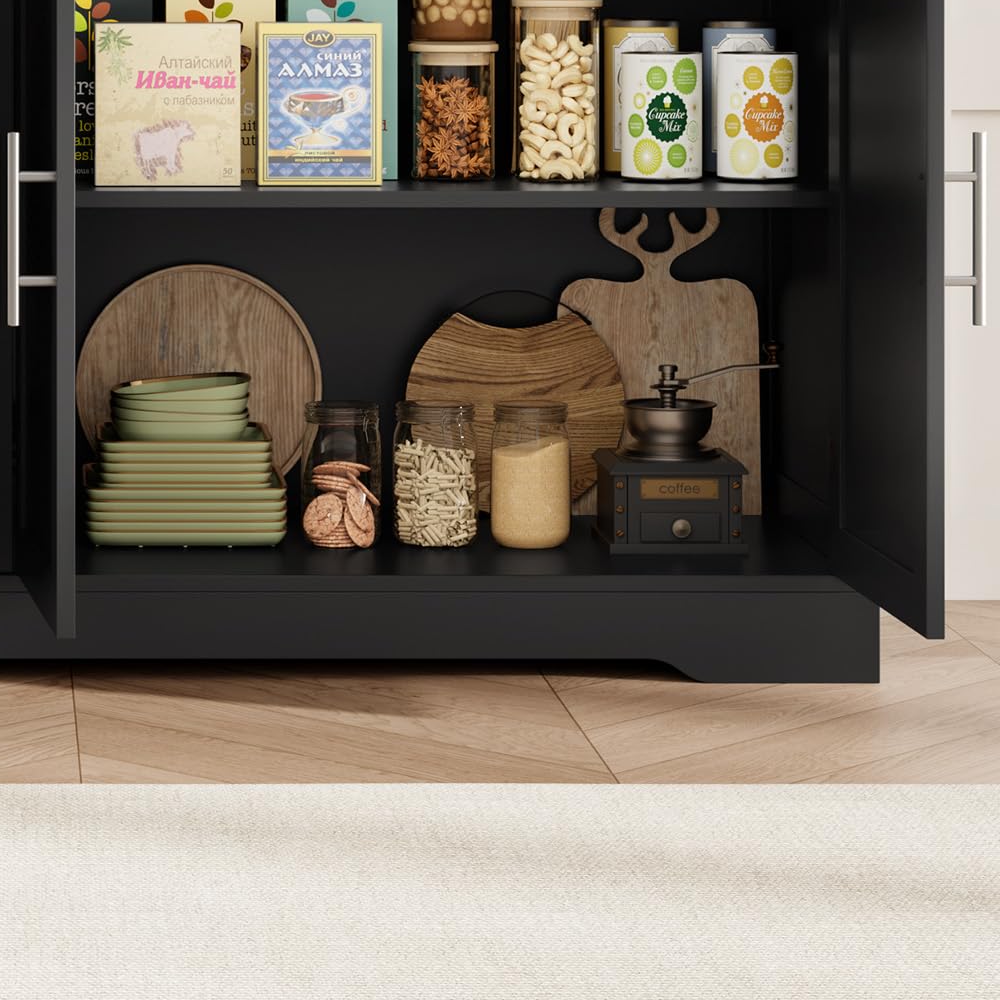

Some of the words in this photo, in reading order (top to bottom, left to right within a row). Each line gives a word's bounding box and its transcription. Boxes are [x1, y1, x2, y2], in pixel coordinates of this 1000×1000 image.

[308, 33, 330, 43] JAY
[158, 55, 232, 69] Алтайский
[277, 62, 363, 78] АЛМАЗ
[135, 70, 237, 89] Иван-чай
[648, 107, 685, 122] Cupcake
[745, 107, 782, 122] Cupcake
[659, 120, 682, 132] Mix
[755, 120, 778, 132] Mix
[658, 482, 701, 494] coffee
